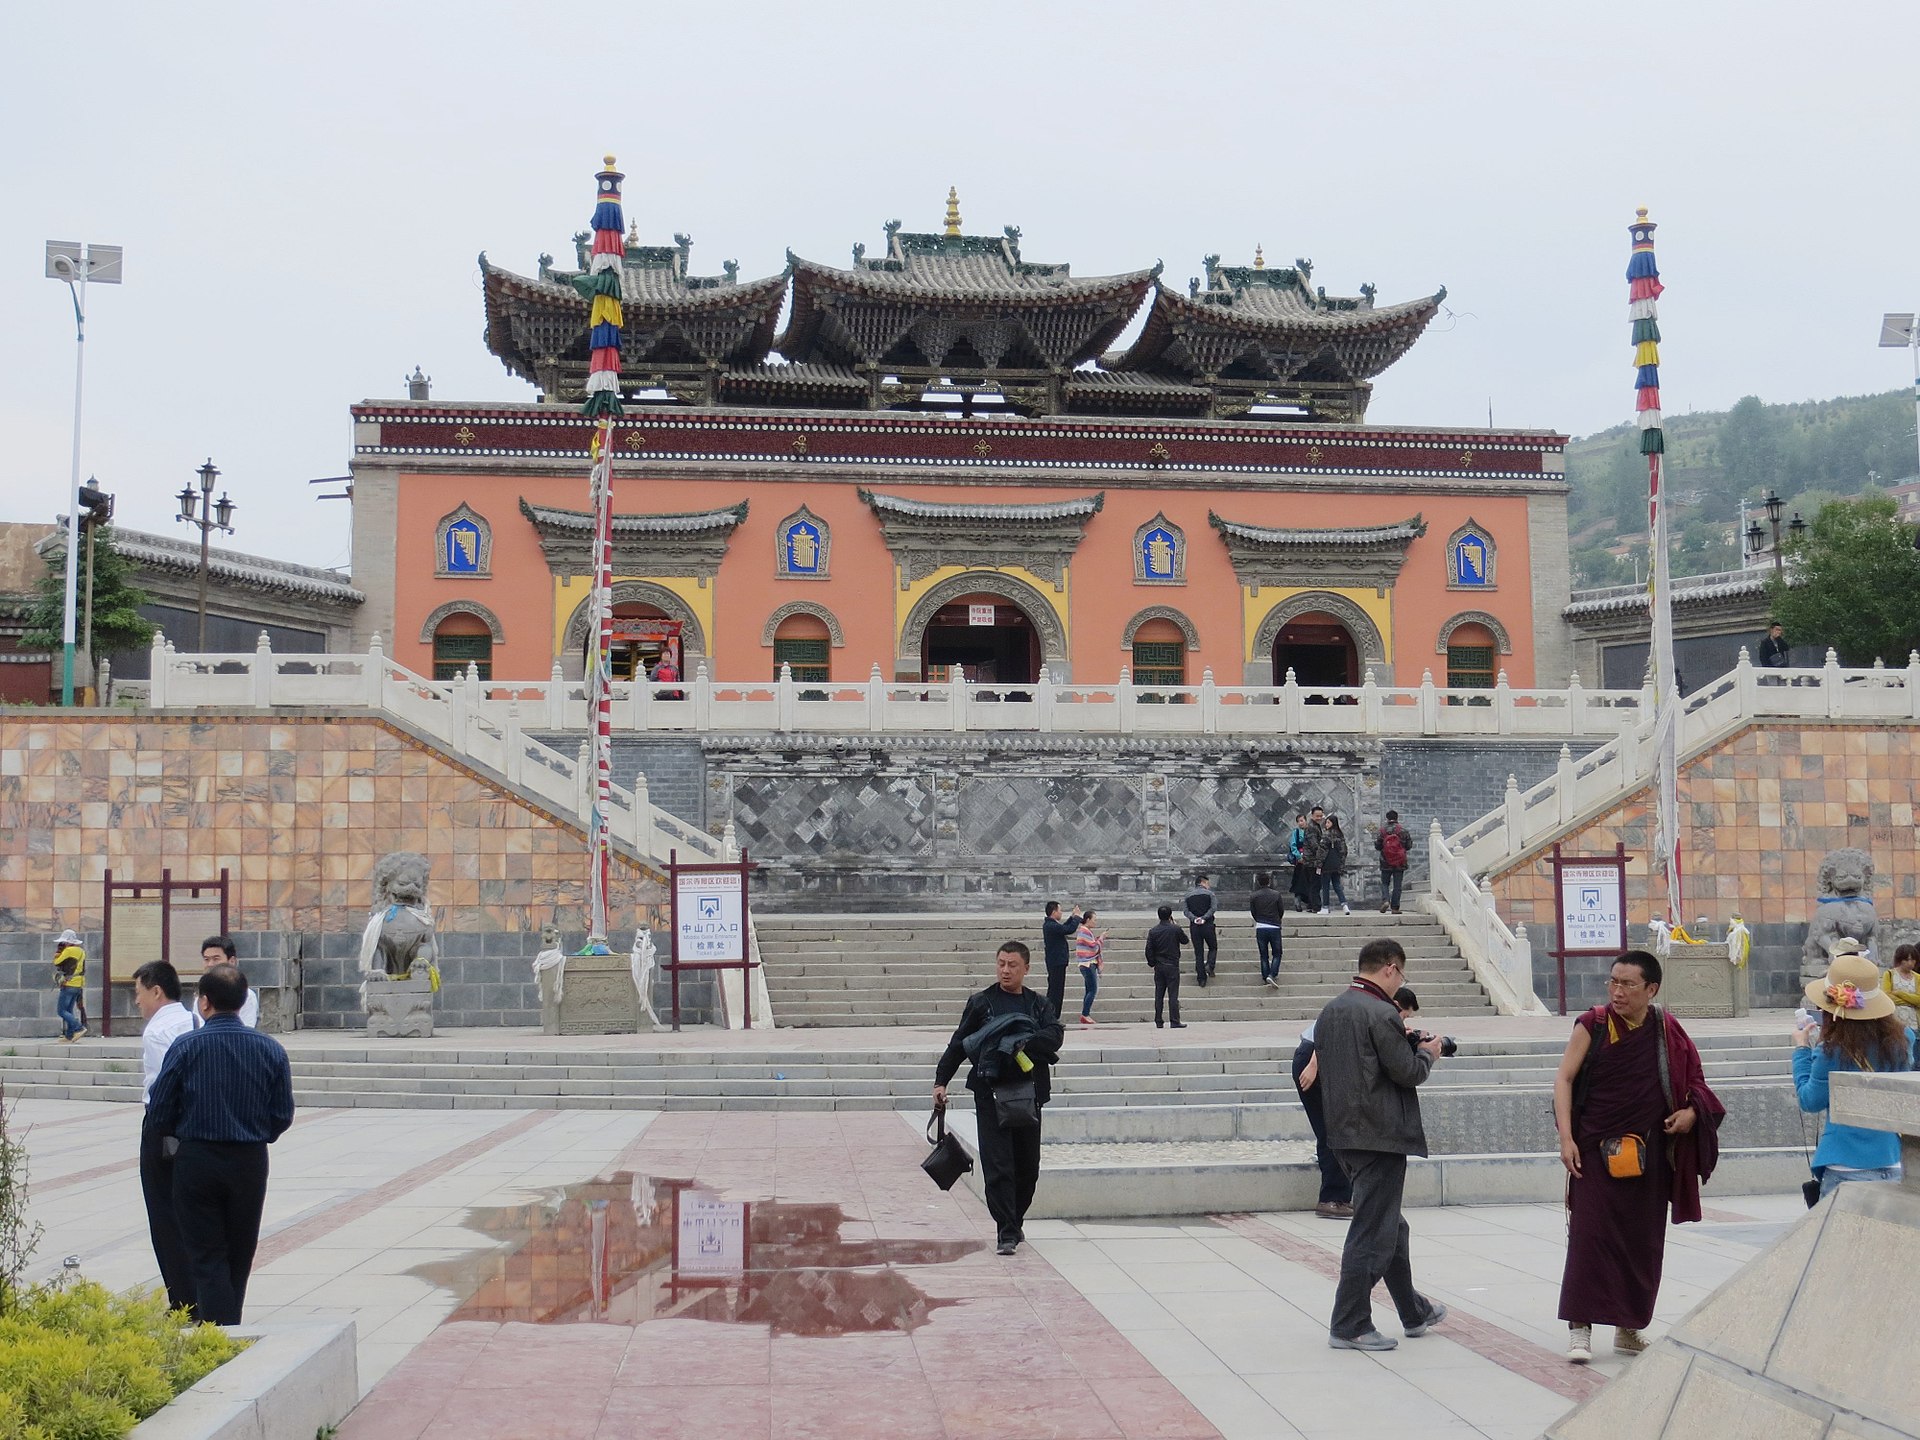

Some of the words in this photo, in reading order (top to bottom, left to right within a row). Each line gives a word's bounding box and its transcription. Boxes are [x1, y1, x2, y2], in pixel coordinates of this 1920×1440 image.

[1567, 914, 1616, 922] 中山门入口
[682, 923, 738, 933] 中山门入口
